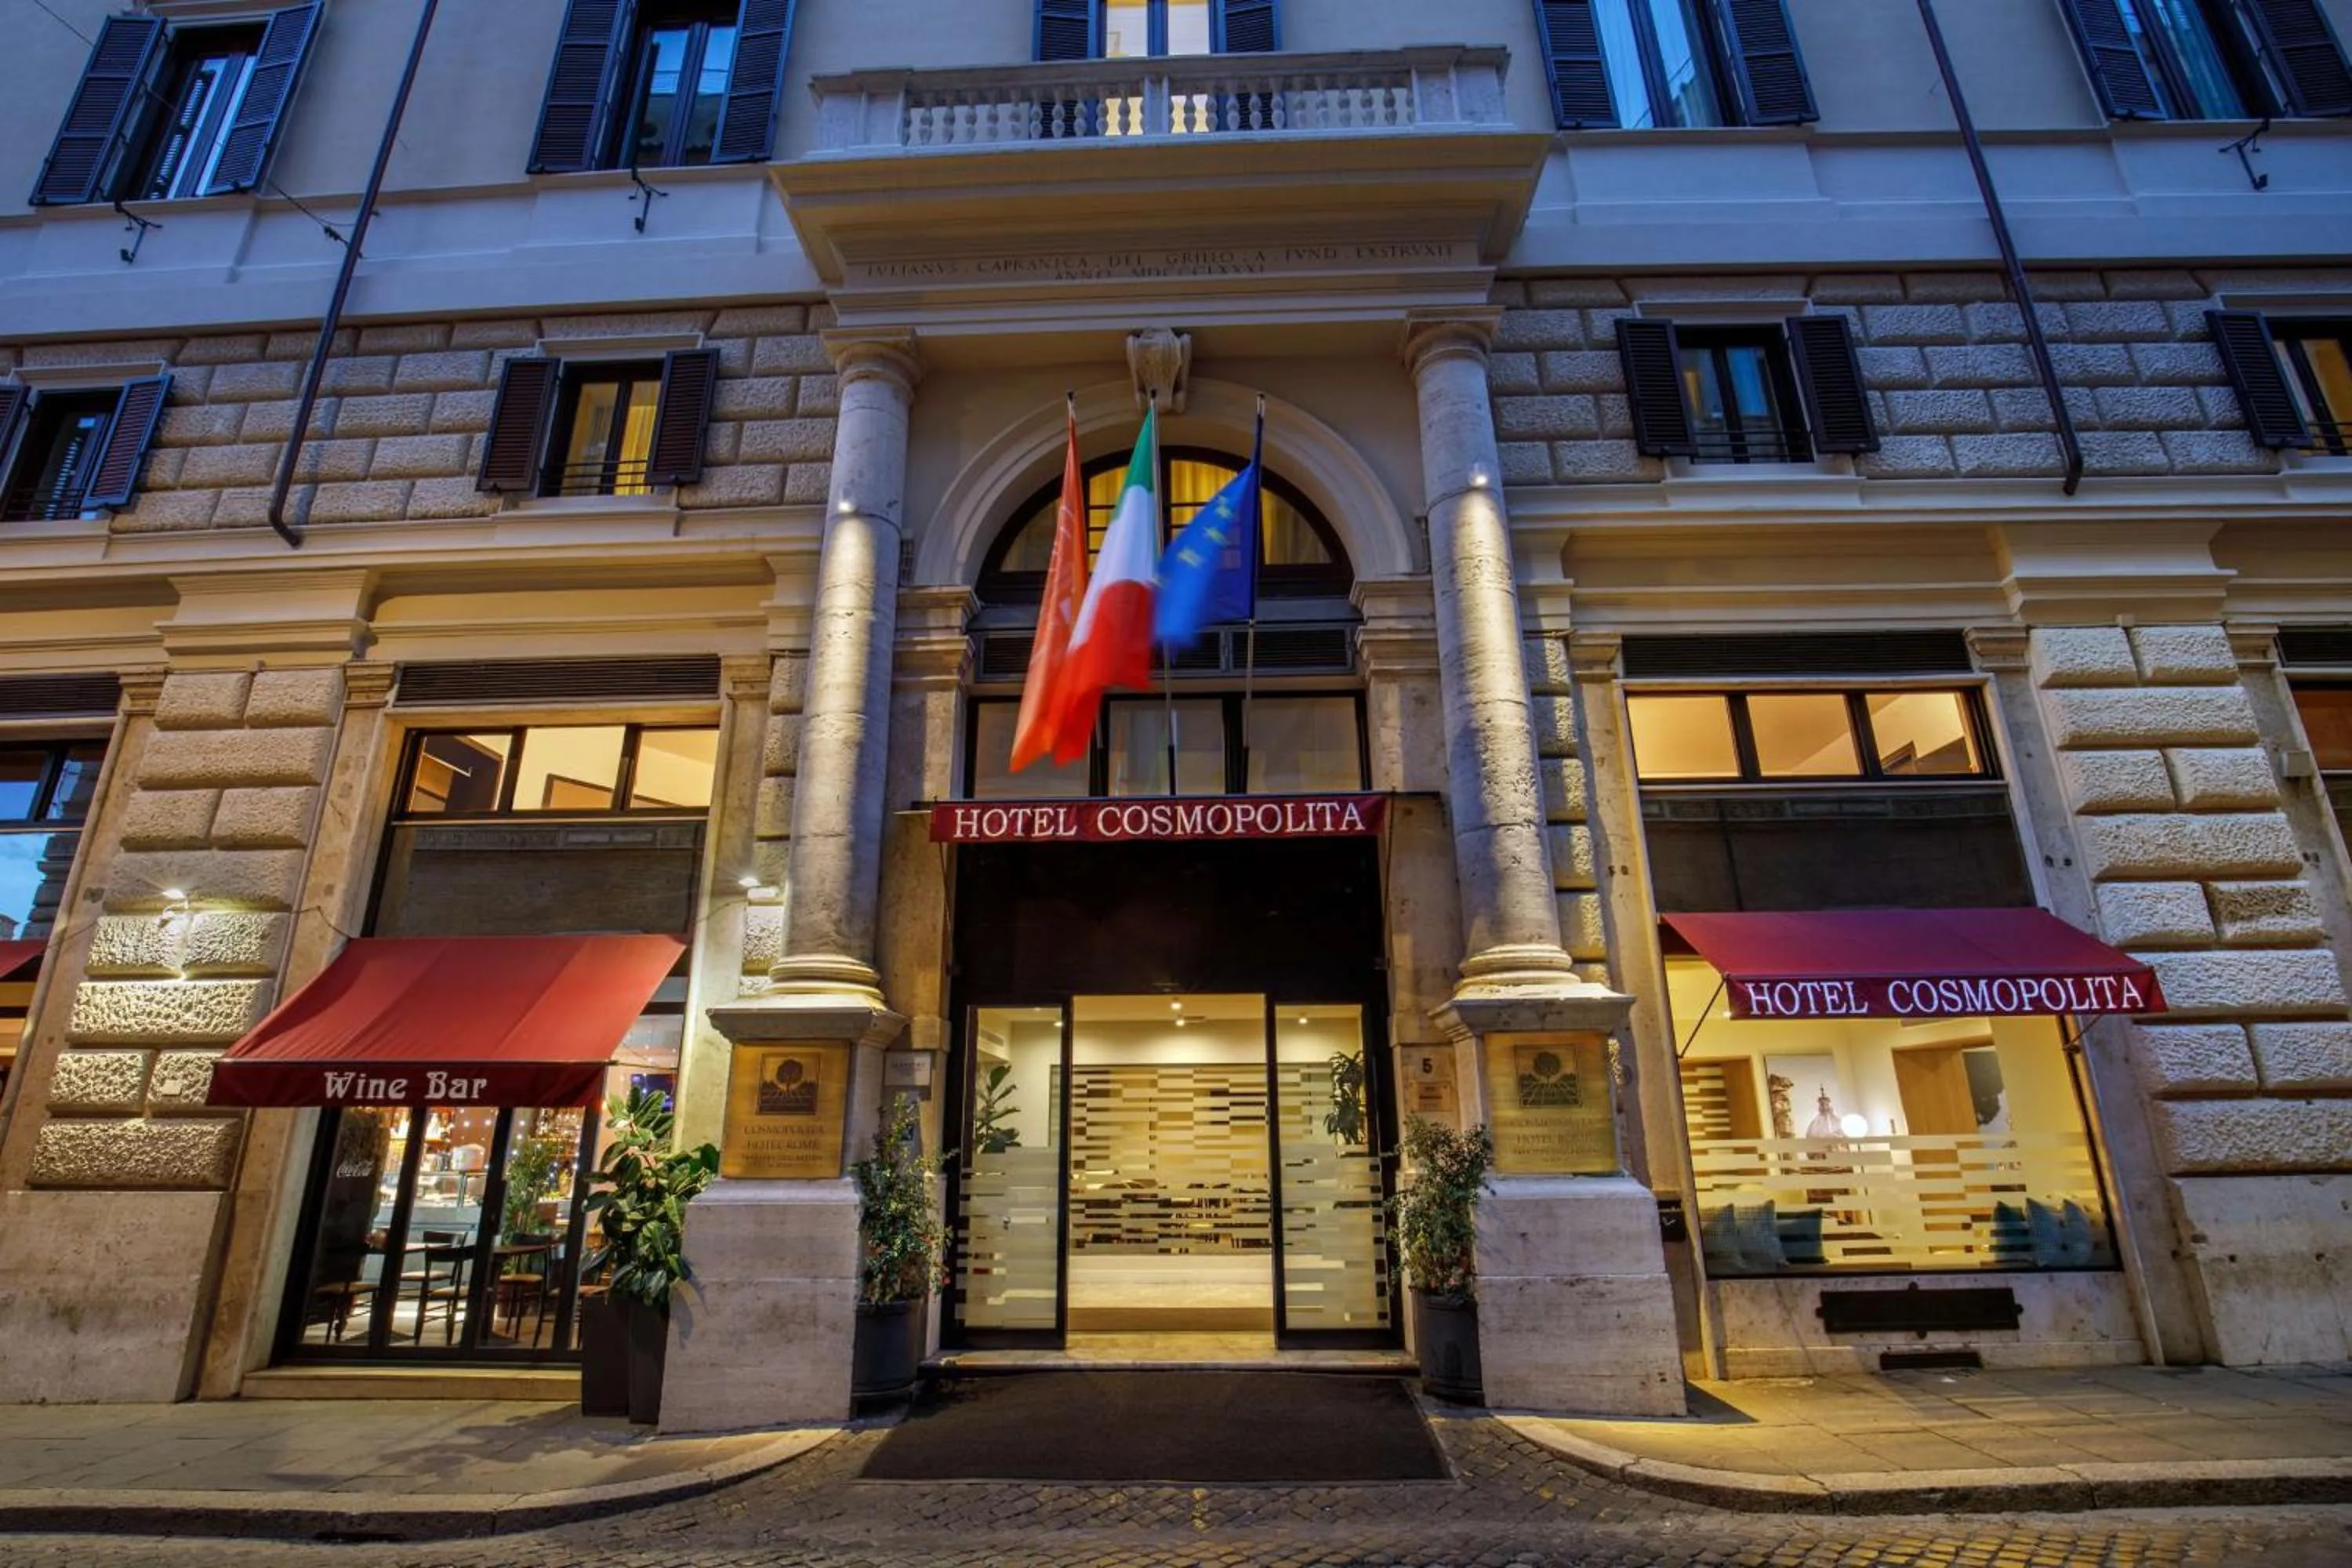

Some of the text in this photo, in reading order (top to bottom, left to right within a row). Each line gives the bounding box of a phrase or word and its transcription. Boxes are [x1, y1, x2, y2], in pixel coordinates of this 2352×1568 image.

[1109, 253, 1143, 267] DEL
[953, 802, 1365, 838] HOTEL COSMOPOLITA
[1747, 976, 2144, 1015] HOTEL COSMOPOLITA
[1422, 1058, 1433, 1074] 5
[324, 1071, 487, 1099] Wine Bar
